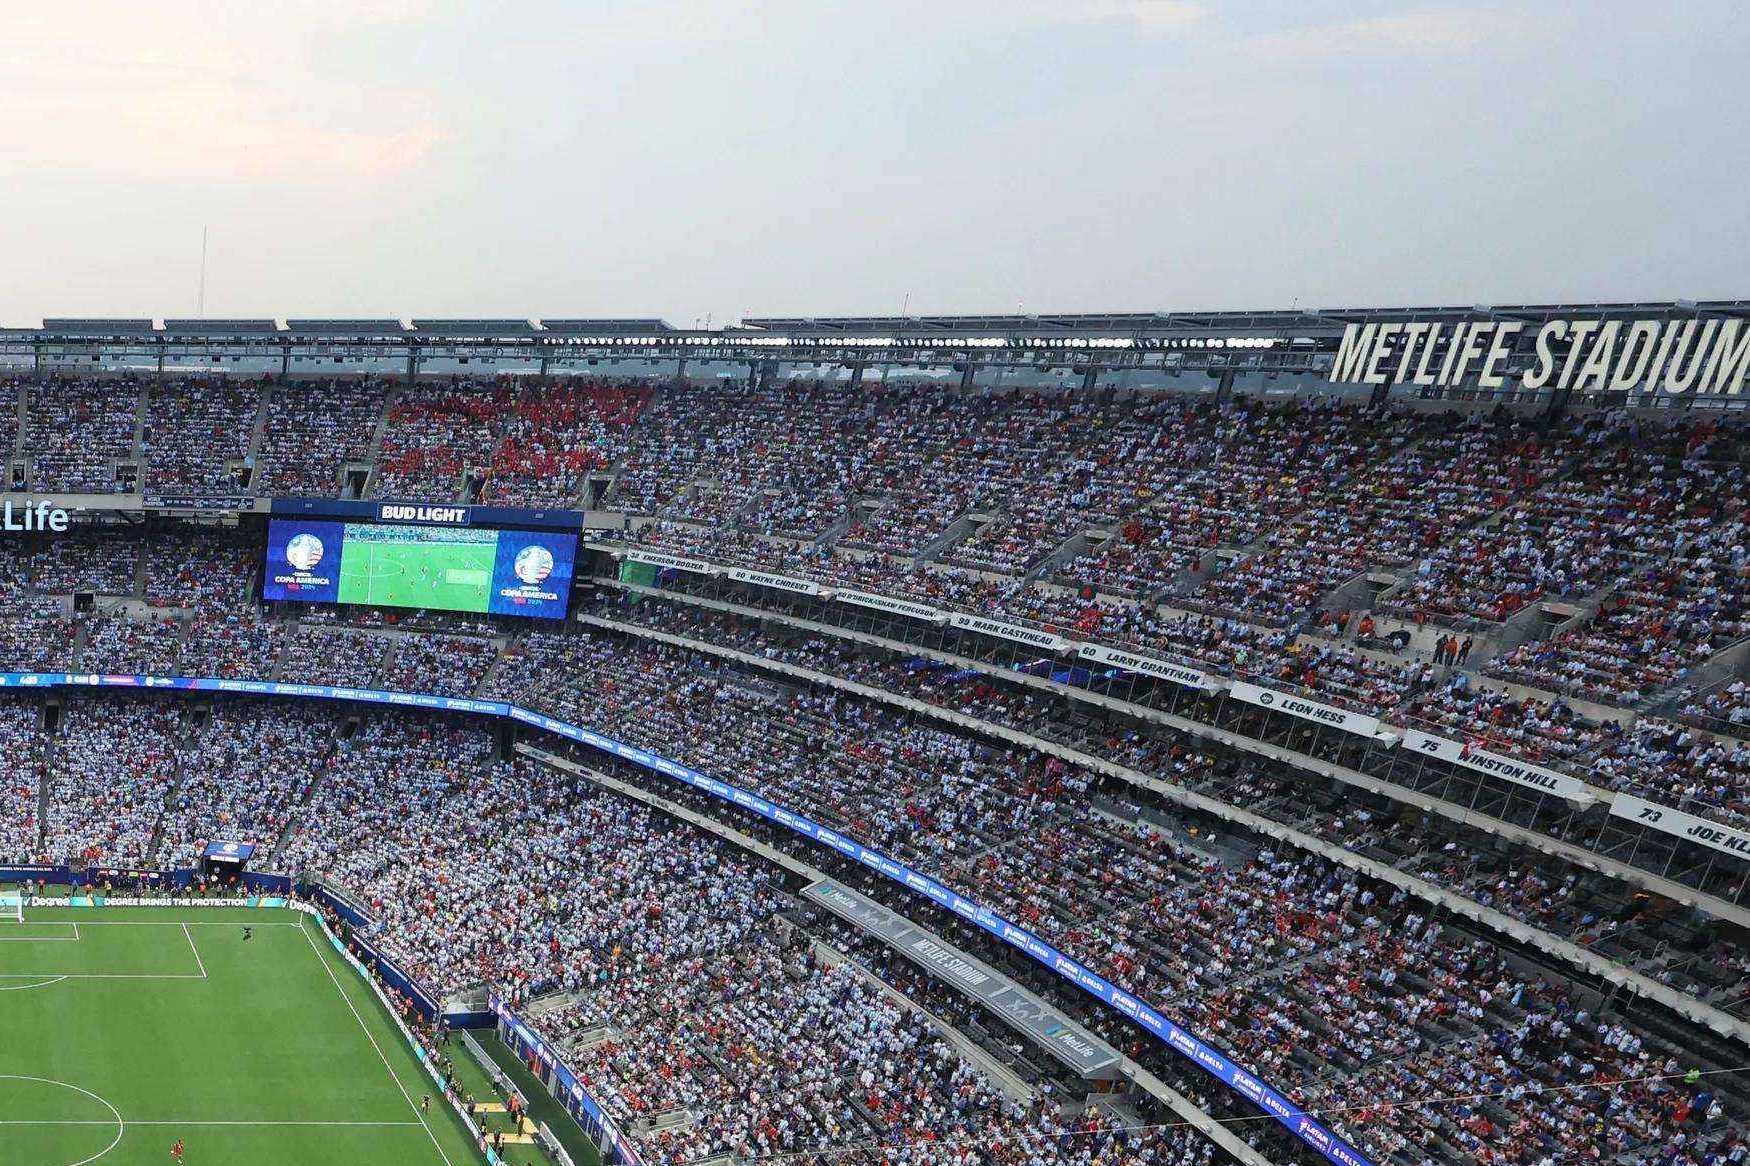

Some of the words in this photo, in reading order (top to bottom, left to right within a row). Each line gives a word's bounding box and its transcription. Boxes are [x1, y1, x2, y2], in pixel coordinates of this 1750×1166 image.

[1329, 321, 1526, 388] METLIFE
[1523, 319, 1750, 394] STADIUM
[382, 505, 415, 520] BUD
[416, 506, 467, 523] LIGHT
[750, 574, 774, 586] WAYNE
[898, 602, 935, 617] FERGUSON
[972, 620, 999, 633] MARK
[1000, 625, 1054, 645] GASTINEAU
[1106, 653, 1139, 668] LARRY
[1140, 662, 1201, 684] GRANTHAM
[1281, 699, 1313, 716] LEON
[1312, 708, 1346, 725] HESS
[1420, 740, 1442, 751] 75
[1458, 751, 1524, 782] WINSTON
[1523, 771, 1558, 791] HILL
[1638, 808, 1663, 823] 73
[1687, 825, 1725, 843] JOE
[1723, 835, 1750, 852] KL
[32, 897, 70, 908] Degree
[104, 897, 138, 907] DEGREE
[139, 897, 172, 907] BRINGS
[173, 897, 191, 907] THE
[192, 897, 248, 907] PROTECTION
[911, 938, 951, 969] METLIFE
[945, 958, 990, 985] STADIUM
[1060, 1033, 1094, 1057] MetLife
[1307, 1124, 1328, 1144] LATAM
